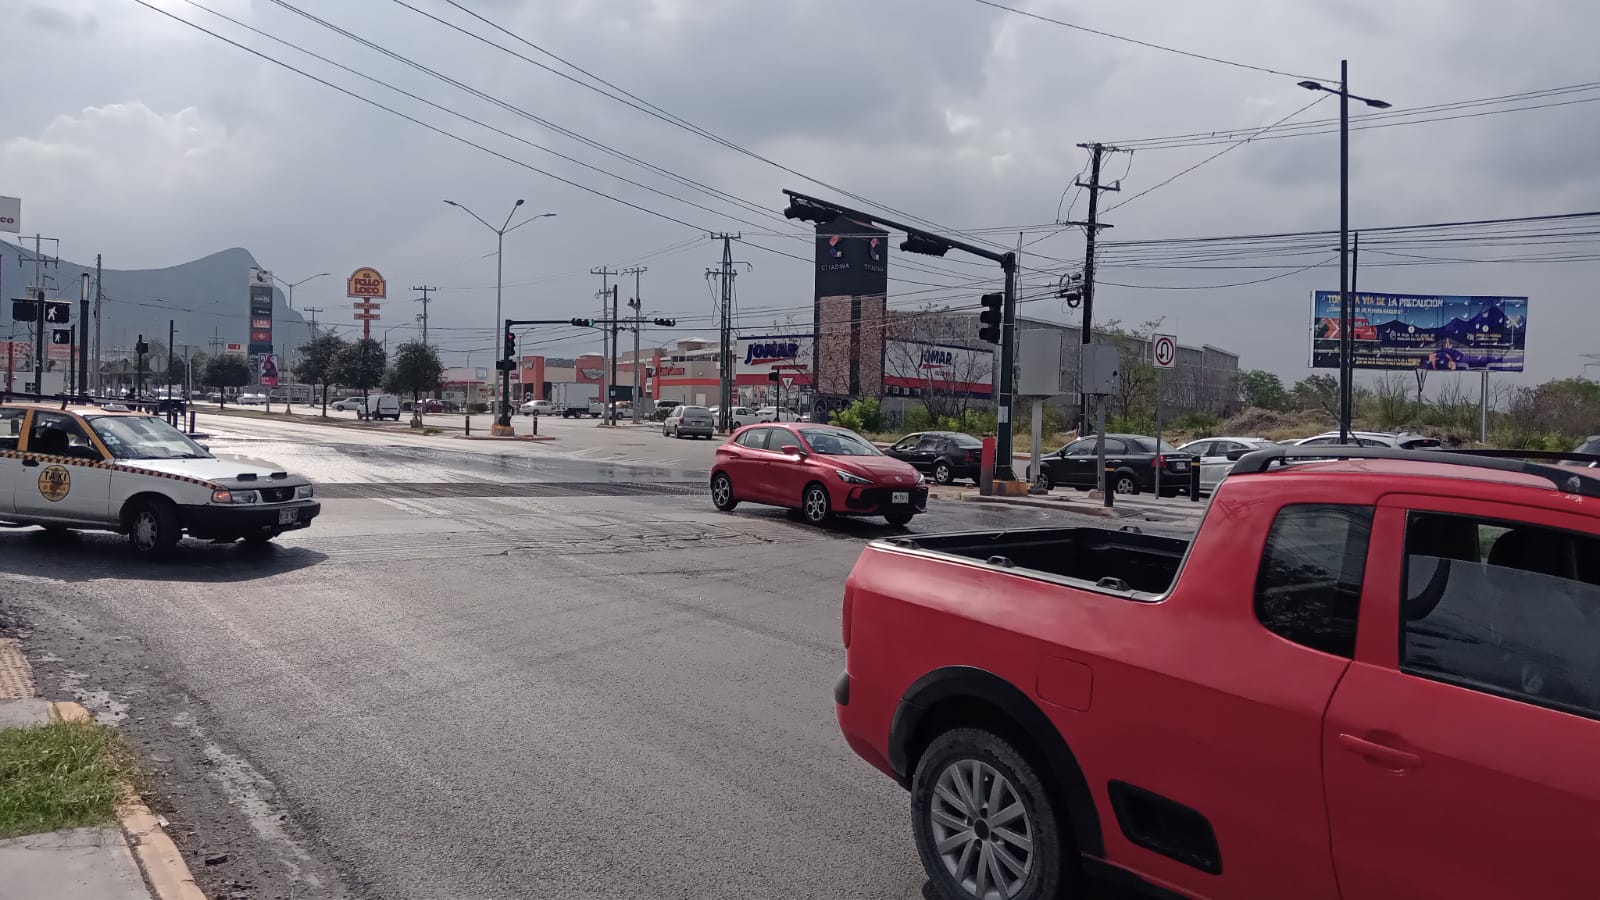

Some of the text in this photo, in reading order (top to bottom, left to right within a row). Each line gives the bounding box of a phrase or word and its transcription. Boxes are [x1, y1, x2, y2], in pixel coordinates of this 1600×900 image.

[354, 278, 380, 286] POLLO
[1388, 298, 1397, 307] LA
[744, 343, 799, 364] JOMAR
[918, 348, 953, 368] JOMAR
[45, 471, 67, 481] TAXI
